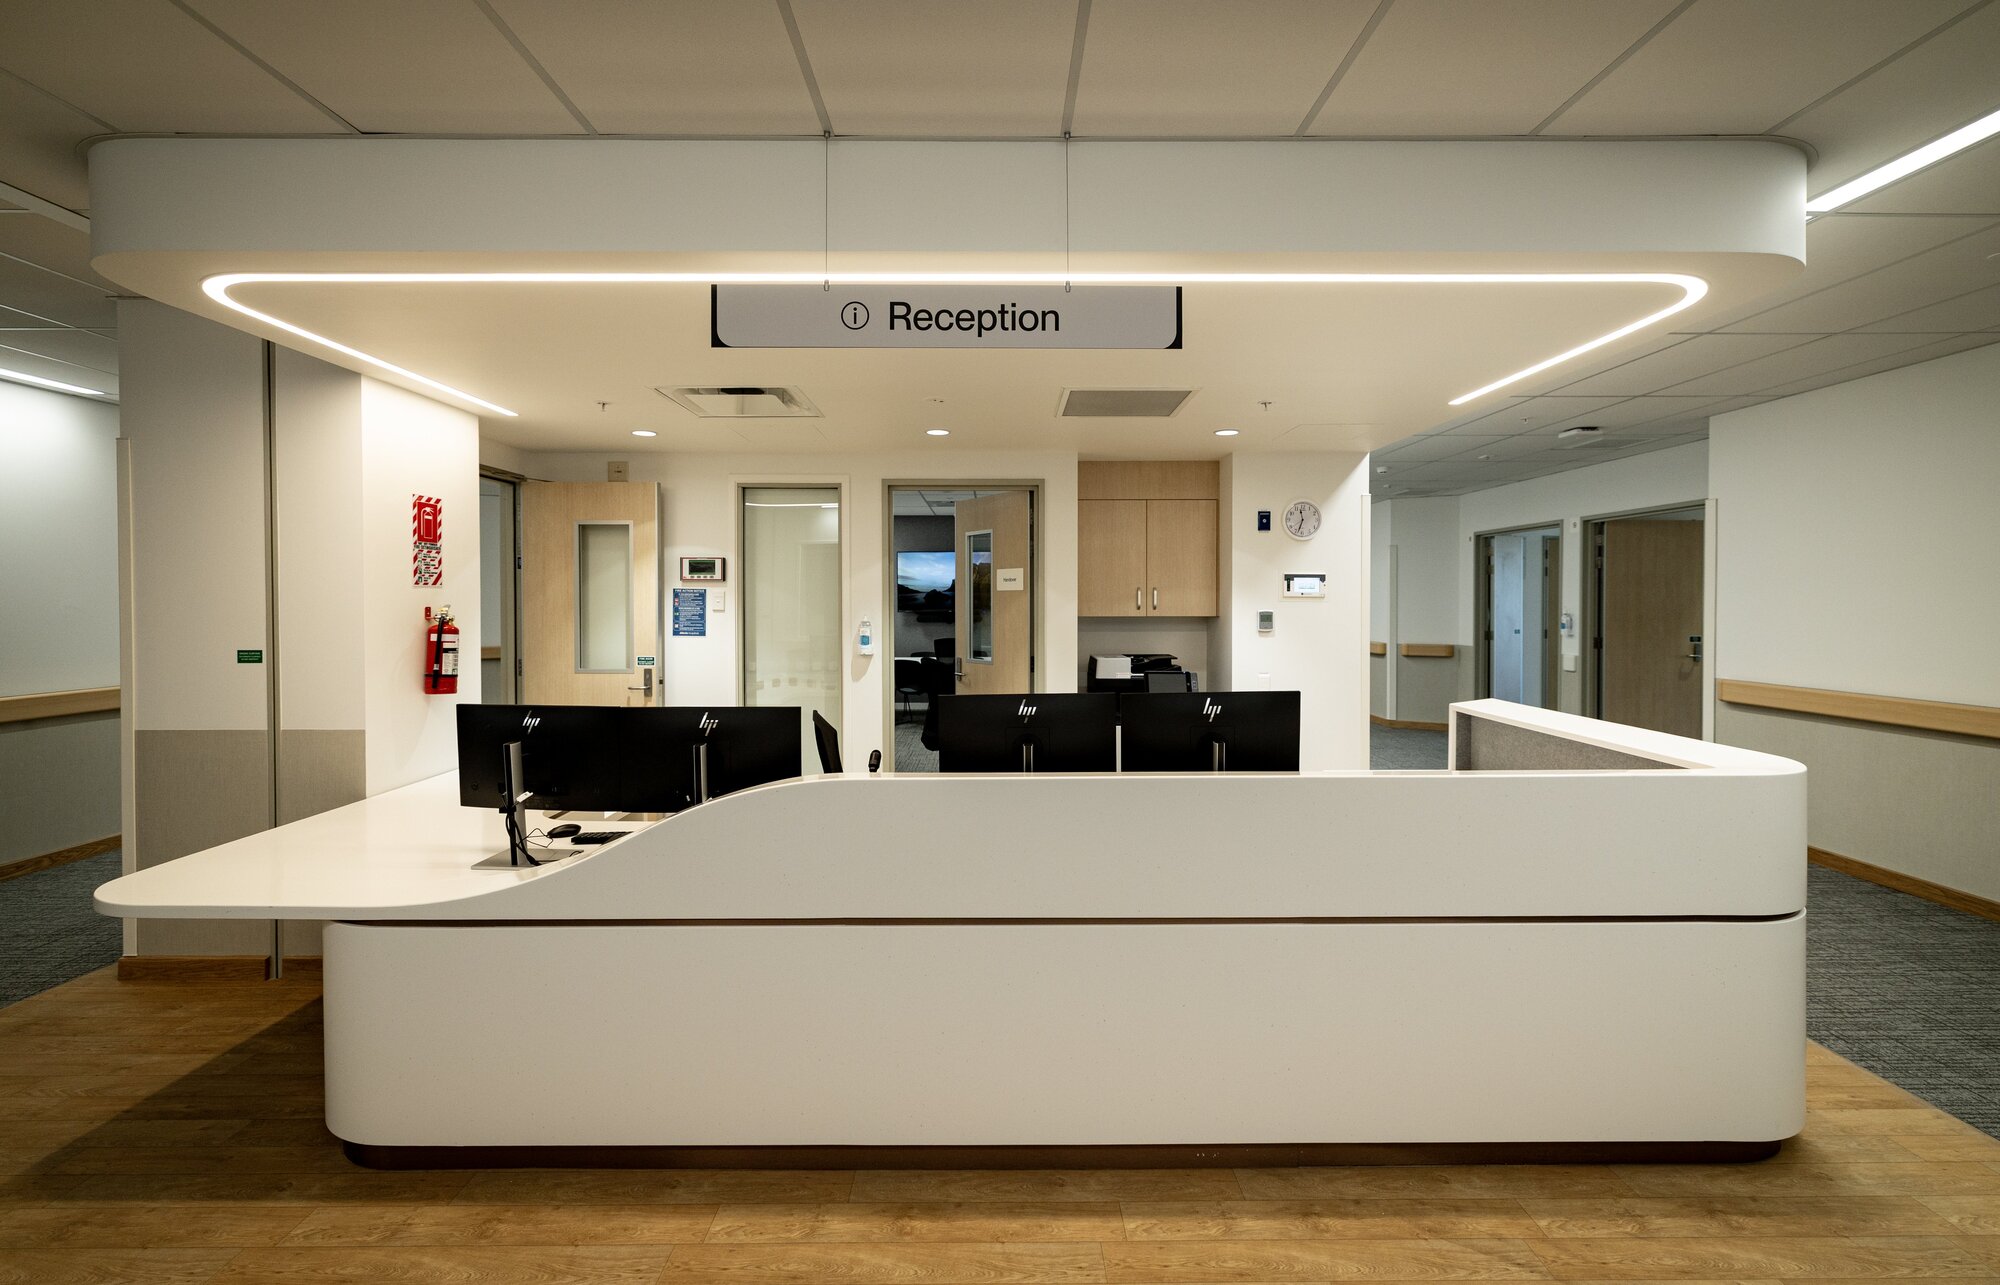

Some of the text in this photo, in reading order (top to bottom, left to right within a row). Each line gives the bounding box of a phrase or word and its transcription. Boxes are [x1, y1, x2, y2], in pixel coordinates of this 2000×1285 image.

[889, 301, 1060, 338] Reception
[522, 710, 541, 734] hp
[1018, 699, 1037, 723] hp
[1203, 698, 1222, 722] hp
[699, 712, 719, 736] hp
